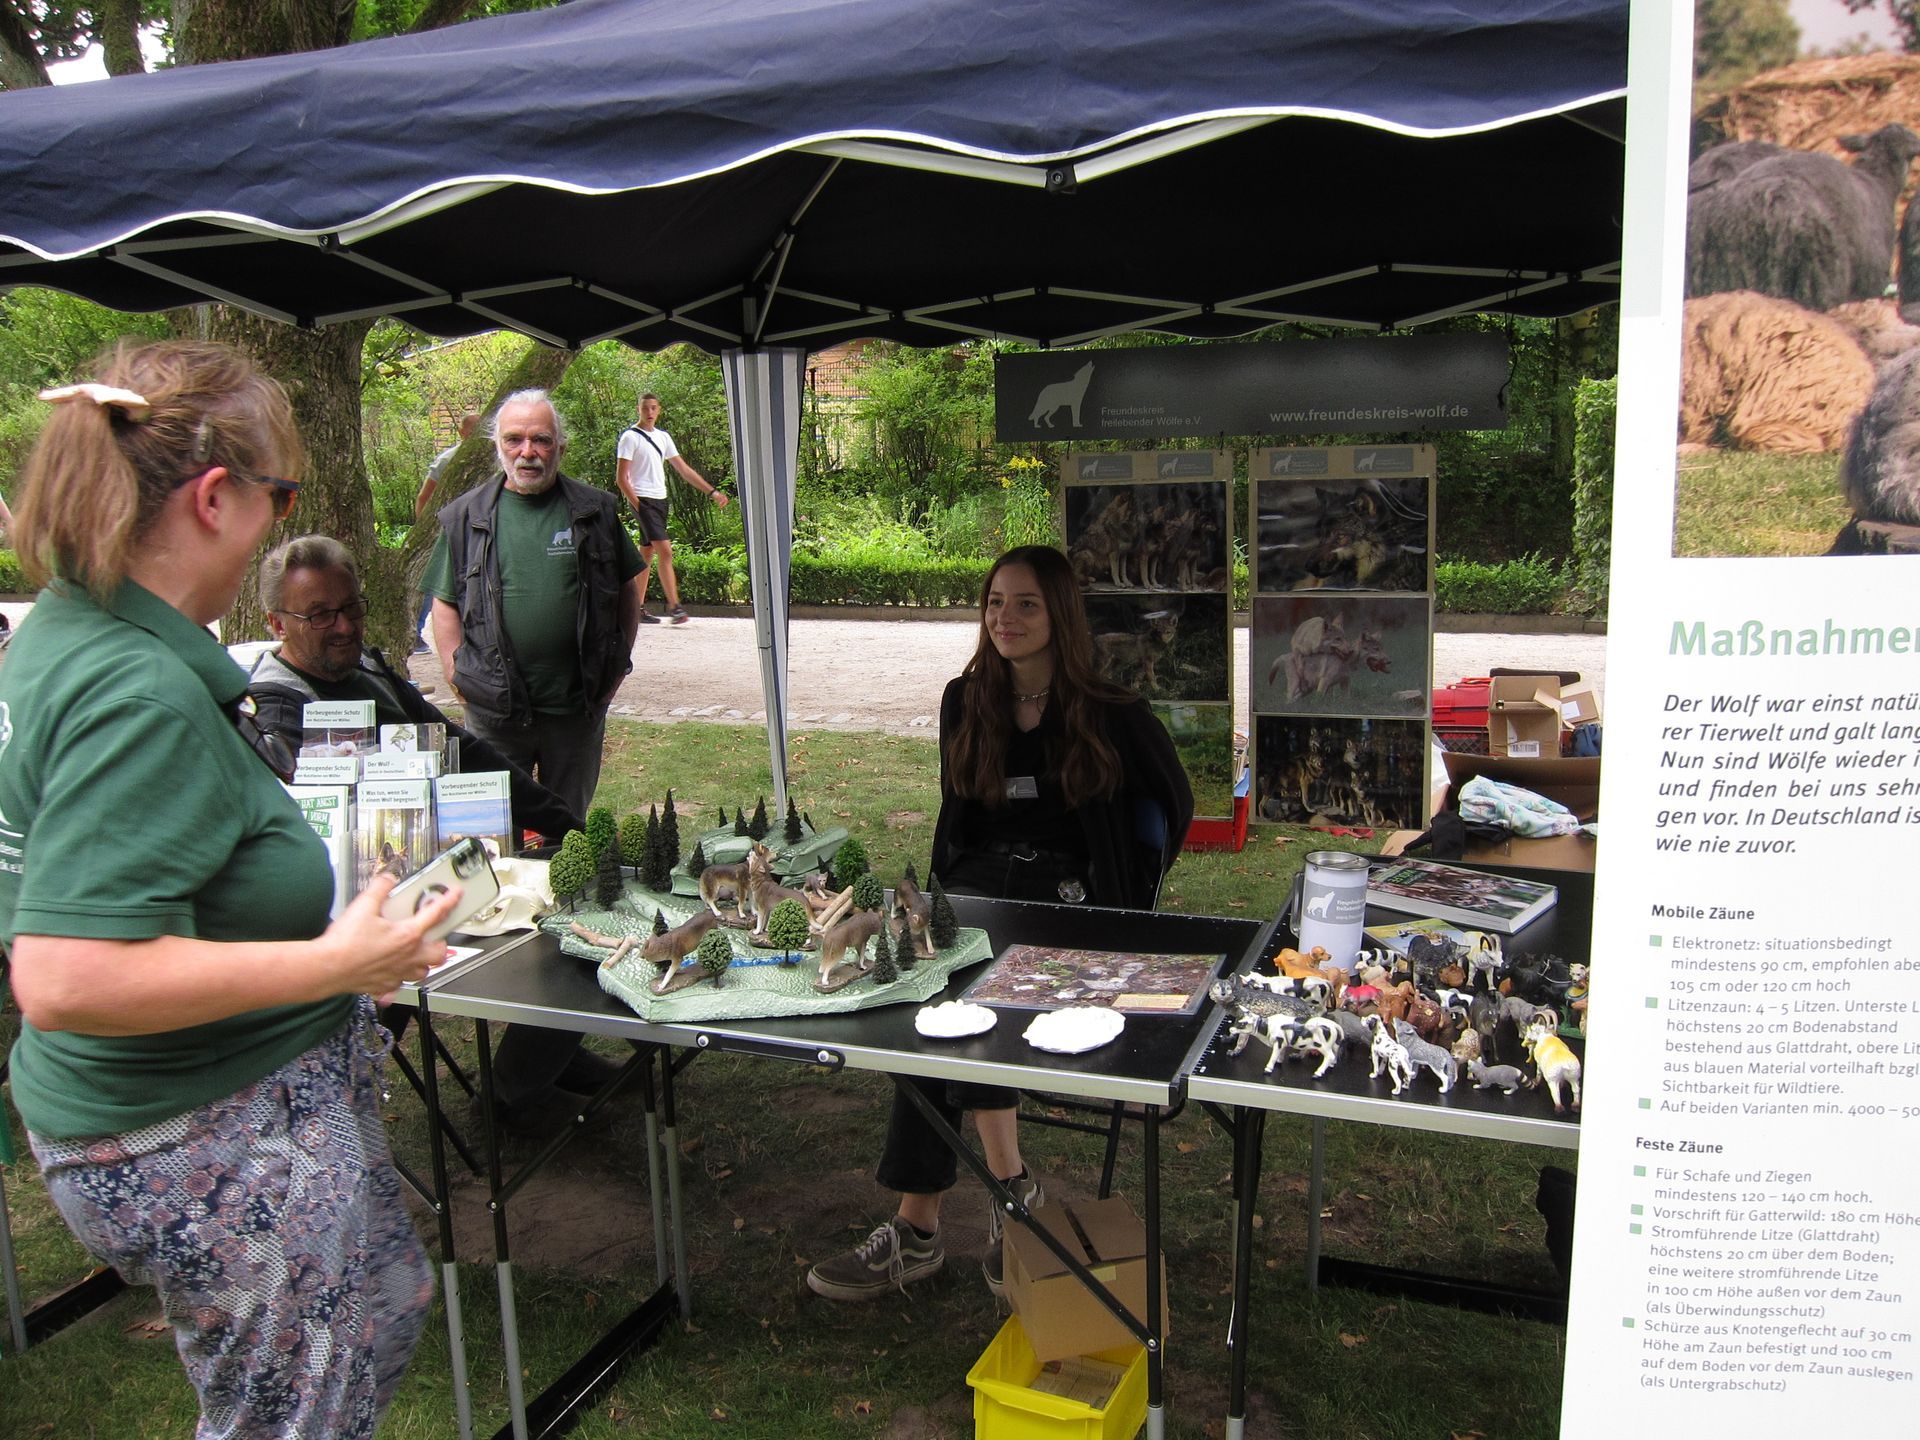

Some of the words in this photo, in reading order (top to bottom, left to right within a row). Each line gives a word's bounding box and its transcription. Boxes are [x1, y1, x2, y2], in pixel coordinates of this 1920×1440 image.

[1101, 406, 1165, 415] Freundeskreis
[1270, 405, 1469, 422] www.freundeskreis-wolf.de
[1669, 618, 1920, 656] Maßnahme
[1664, 695, 1703, 712] Der
[1711, 694, 1762, 717] Wolf
[1767, 699, 1806, 712] war
[1812, 694, 1864, 712] einst
[1662, 727, 1693, 740] rer
[1700, 723, 1784, 741] Tierwelt
[1789, 722, 1830, 741] und
[1833, 722, 1876, 745] galt
[1661, 751, 1704, 768] Nun
[1713, 752, 1760, 769] sind
[1769, 751, 1826, 773] Wölfe
[1836, 750, 1907, 768] wieder
[1659, 779, 1700, 796] und
[1709, 780, 1777, 801] finden
[1788, 779, 1821, 797] bei
[1830, 783, 1867, 797] uns
[1656, 811, 1696, 828] gen
[1703, 812, 1738, 825] vor.
[1746, 809, 1765, 825] In
[1771, 806, 1902, 825] Deutschland
[1657, 834, 1692, 852] wie
[1698, 836, 1730, 853] nie
[1735, 839, 1795, 853] zuvor.
[1652, 904, 1704, 919] Mobile
[1709, 907, 1754, 920] Zäune
[1673, 936, 1760, 950] Elektronetz:
[1765, 937, 1892, 952] situationsbedingt
[1671, 957, 1756, 971] mindestens
[1761, 962, 1778, 974] 90
[1783, 962, 1807, 972] cm,
[1812, 957, 1889, 973] empfohlen
[1670, 981, 1694, 993] 105
[1700, 982, 1720, 992] cm
[1725, 980, 1758, 992] oder
[1763, 983, 1787, 992] 120
[1791, 982, 1811, 992] cm
[1816, 979, 1850, 991] hoch
[1668, 998, 1751, 1013] Litzenzaun:
[1794, 1000, 1839, 1012] Litzen.
[1845, 1000, 1907, 1012] Unterste
[1667, 1018, 1741, 1033] höchstens
[1746, 1024, 1764, 1033] 20
[1768, 1024, 1788, 1033] cm
[1793, 1020, 1898, 1033] Bodenabstand
[1666, 1039, 1742, 1054] bestehend
[1747, 1044, 1772, 1054] aus
[1776, 1041, 1852, 1055] Glattdraht,
[1857, 1041, 1899, 1054] obere
[1664, 1062, 1689, 1072] aus
[1694, 1061, 1743, 1074] blauen
[1748, 1062, 1805, 1074] Material
[1810, 1061, 1884, 1074] vorteilhaft
[1663, 1080, 1749, 1094] Sichtbarkeit
[1754, 1082, 1774, 1094] für
[1777, 1082, 1843, 1094] Wildtiere.
[1660, 1100, 1686, 1112] Auf
[1690, 1101, 1738, 1114] beiden
[1742, 1102, 1808, 1114] Varianten
[1813, 1102, 1843, 1114] min.
[1848, 1105, 1885, 1117] 4000
[1636, 1137, 1674, 1151] Feste
[1679, 1141, 1723, 1153] Zäune
[1656, 1168, 1679, 1180] Für
[1683, 1169, 1730, 1182] Schafe
[1735, 1171, 1761, 1182] und
[1765, 1170, 1811, 1185] Ziegen
[1655, 1188, 1736, 1202] mindestens
[1742, 1193, 1765, 1202] 120
[1782, 1193, 1805, 1204] 140
[1809, 1193, 1829, 1202] cm
[1834, 1190, 1872, 1203] hoch.
[1653, 1206, 1721, 1221] Vorschrift
[1726, 1209, 1745, 1221] für
[1749, 1209, 1825, 1221] Gatterwild:
[1831, 1211, 1855, 1222] 180
[1859, 1214, 1880, 1223] cm
[1652, 1225, 1757, 1240] Stromführende
[1761, 1229, 1793, 1240] Litze
[1798, 1228, 1880, 1244] (Glattdraht)
[1650, 1244, 1722, 1259] höchstens
[1727, 1251, 1744, 1260] 20
[1748, 1251, 1767, 1260] cm
[1772, 1248, 1804, 1260] über
[1808, 1248, 1838, 1260] dem
[1843, 1249, 1894, 1265] Boden;
[1648, 1264, 1678, 1276] eine
[1683, 1267, 1734, 1278] weitere
[1738, 1267, 1841, 1280] stromführende
[1846, 1269, 1878, 1282] Litze
[1648, 1282, 1659, 1294] in
[1665, 1287, 1688, 1296] 100
[1693, 1288, 1712, 1296] cm
[1717, 1286, 1752, 1297] Höhe
[1757, 1286, 1800, 1297] außen
[1804, 1289, 1827, 1298] vor
[1830, 1288, 1861, 1300] dem
[1865, 1289, 1901, 1303] Zaun
[1647, 1300, 1671, 1314] (als
[1676, 1301, 1825, 1319] Überwindungsschutz)
[1644, 1320, 1699, 1334] Schürze
[1704, 1326, 1728, 1335] aus
[1733, 1324, 1837, 1337] Knotengeflecht
[1841, 1327, 1866, 1338] auf
[1868, 1331, 1887, 1342] 30
[1890, 1331, 1912, 1342] cm
[1643, 1338, 1679, 1351] Höhe
[1684, 1344, 1704, 1352] am
[1708, 1342, 1742, 1353] Zaun
[1746, 1342, 1807, 1356] befestigt
[1811, 1344, 1837, 1356] und
[1842, 1348, 1867, 1358] 100
[1871, 1350, 1892, 1360] cm
[1641, 1358, 1664, 1368] auf
[1667, 1359, 1697, 1370] dem
[1702, 1360, 1745, 1372] Boden
[1749, 1363, 1771, 1372] vor
[1774, 1361, 1804, 1372] dem
[1808, 1362, 1843, 1375] Zaun
[1848, 1366, 1913, 1382] auslegen
[1641, 1374, 1665, 1387] (als
[1669, 1377, 1786, 1392] Untergrabschutz)
